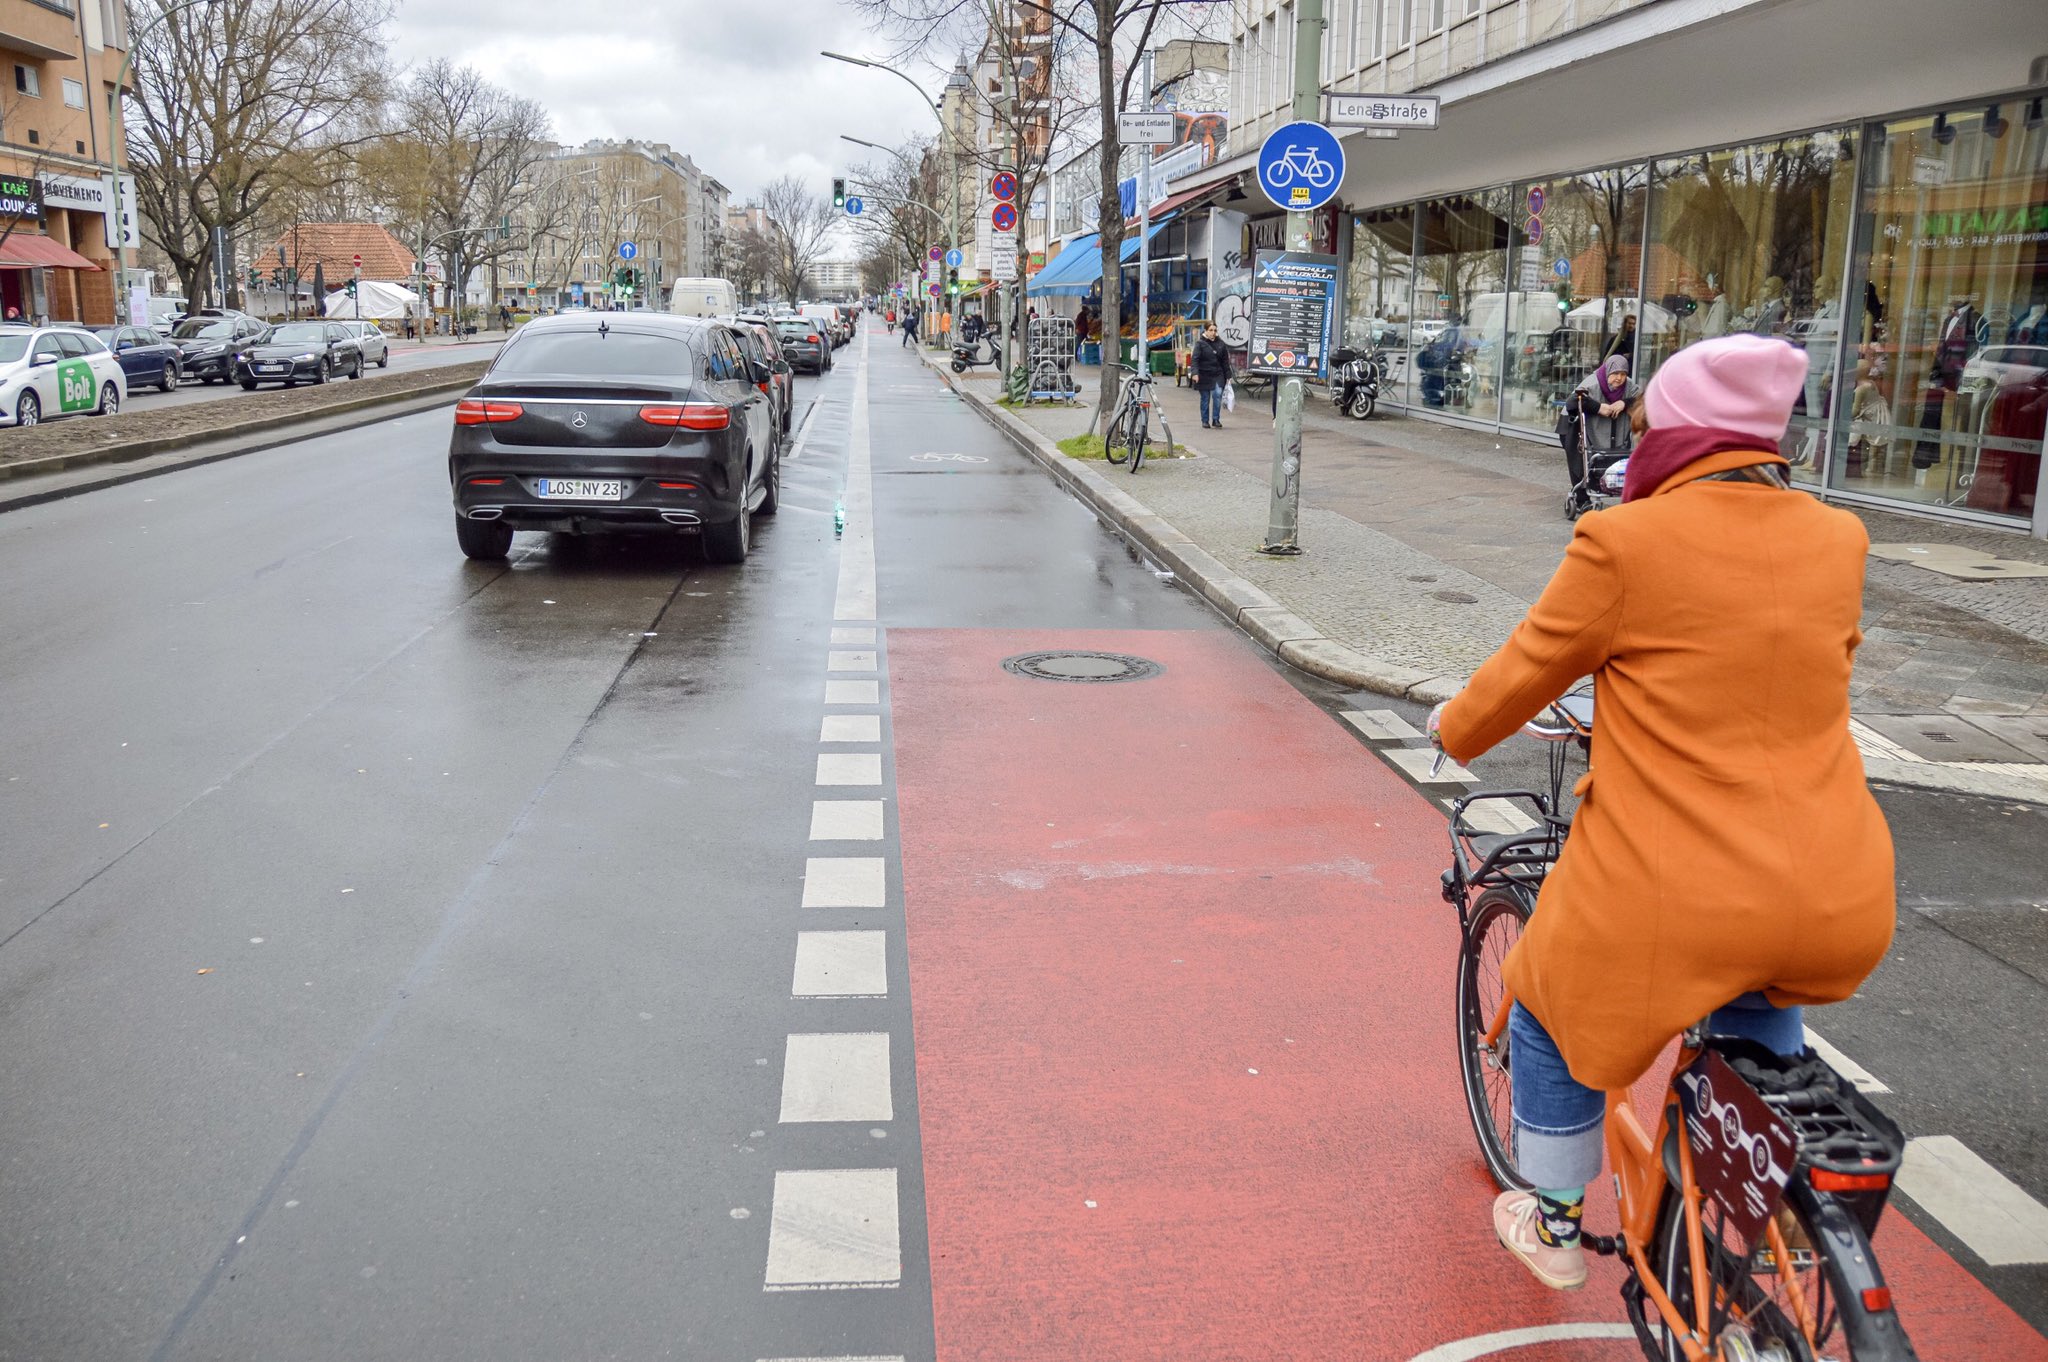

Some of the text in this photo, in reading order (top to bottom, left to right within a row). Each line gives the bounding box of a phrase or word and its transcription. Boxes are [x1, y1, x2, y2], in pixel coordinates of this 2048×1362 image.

[1338, 100, 1428, 120] Lenastraße
[45, 183, 103, 202] MOVIEMENTO
[1277, 265, 1327, 273] FAHRSCHULE
[1277, 270, 1333, 280] KREUZKÖLLN
[64, 375, 90, 402] Bolt
[548, 481, 619, 496] LOS NY 23
